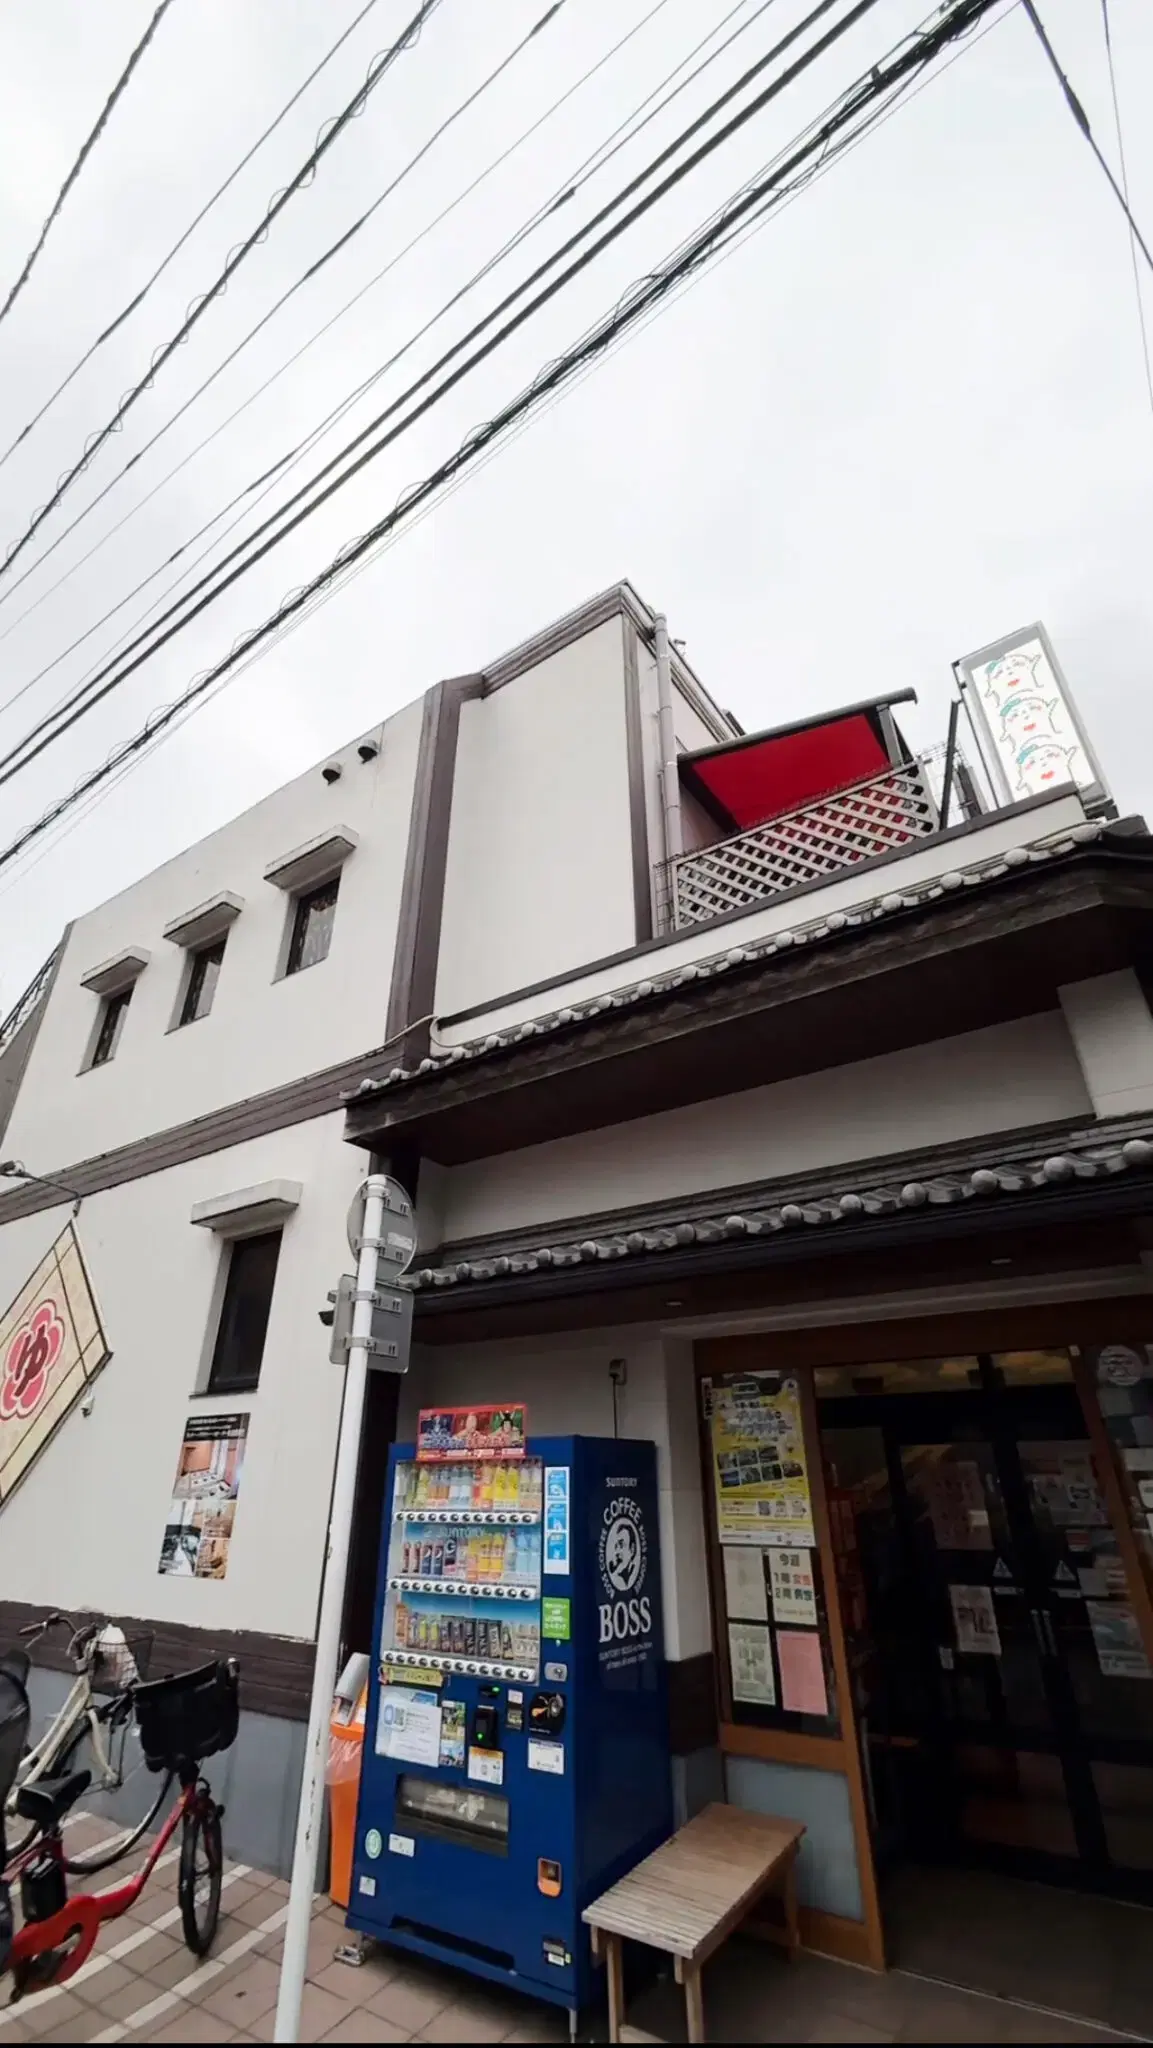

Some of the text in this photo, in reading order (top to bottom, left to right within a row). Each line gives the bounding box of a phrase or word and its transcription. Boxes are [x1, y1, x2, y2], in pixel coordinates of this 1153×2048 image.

[14, 1323, 49, 1397] ゆ
[605, 1477, 638, 1488] SUNTORY
[603, 1497, 643, 1526] COFFEE
[598, 1596, 652, 1643] BOSS
